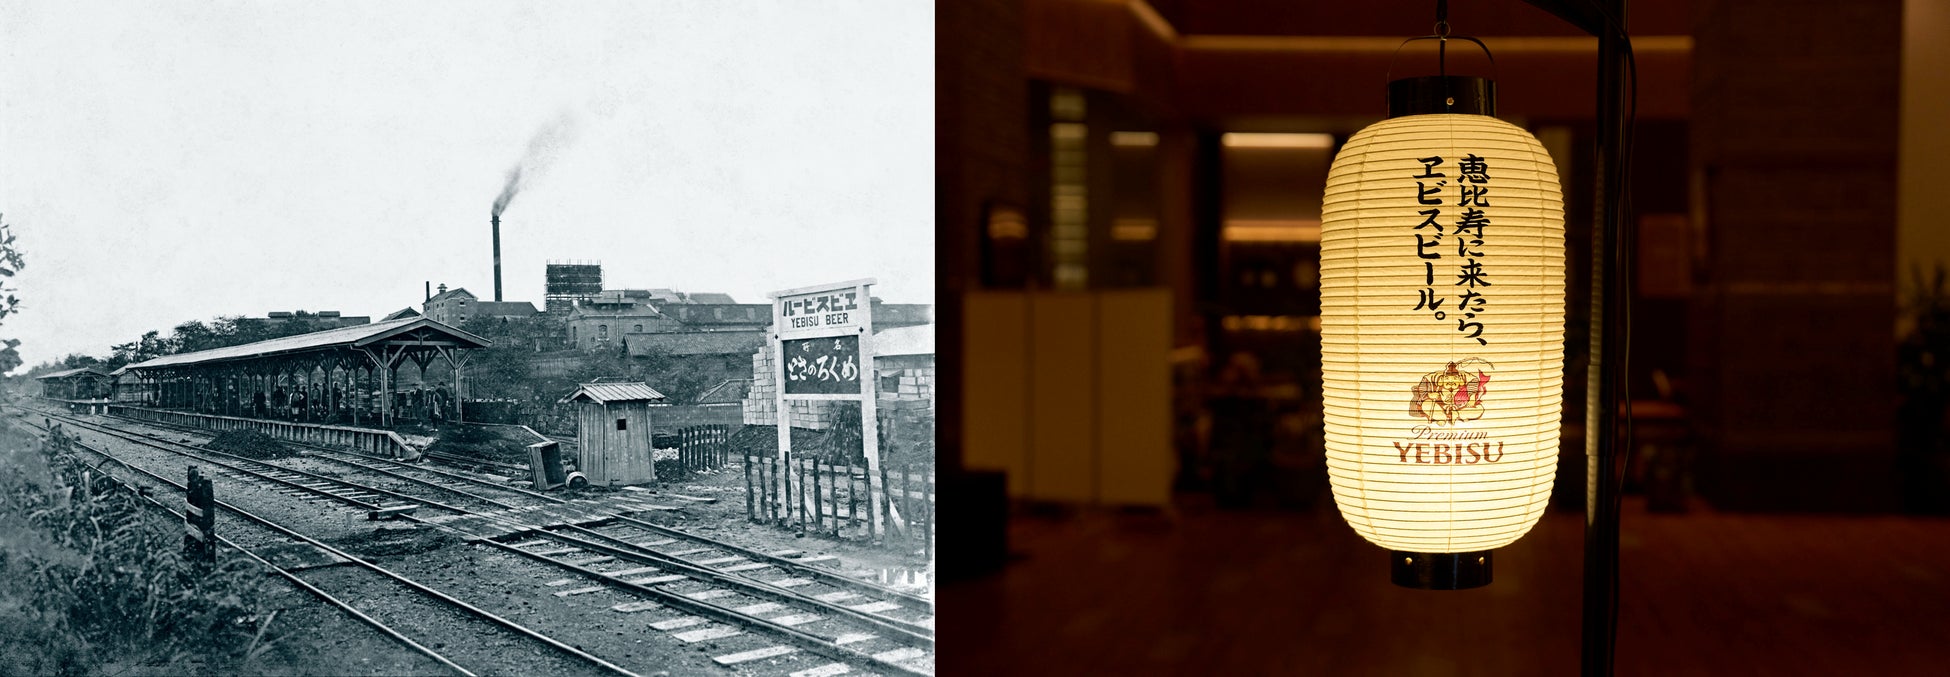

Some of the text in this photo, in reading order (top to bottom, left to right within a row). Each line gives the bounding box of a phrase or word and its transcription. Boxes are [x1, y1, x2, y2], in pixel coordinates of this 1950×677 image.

[1453, 153, 1492, 346] 恵比寿に来たら、
[791, 312, 850, 329] YEBISU BEER
[1407, 425, 1489, 441] Premium
[1392, 441, 1504, 465] YEBISU
